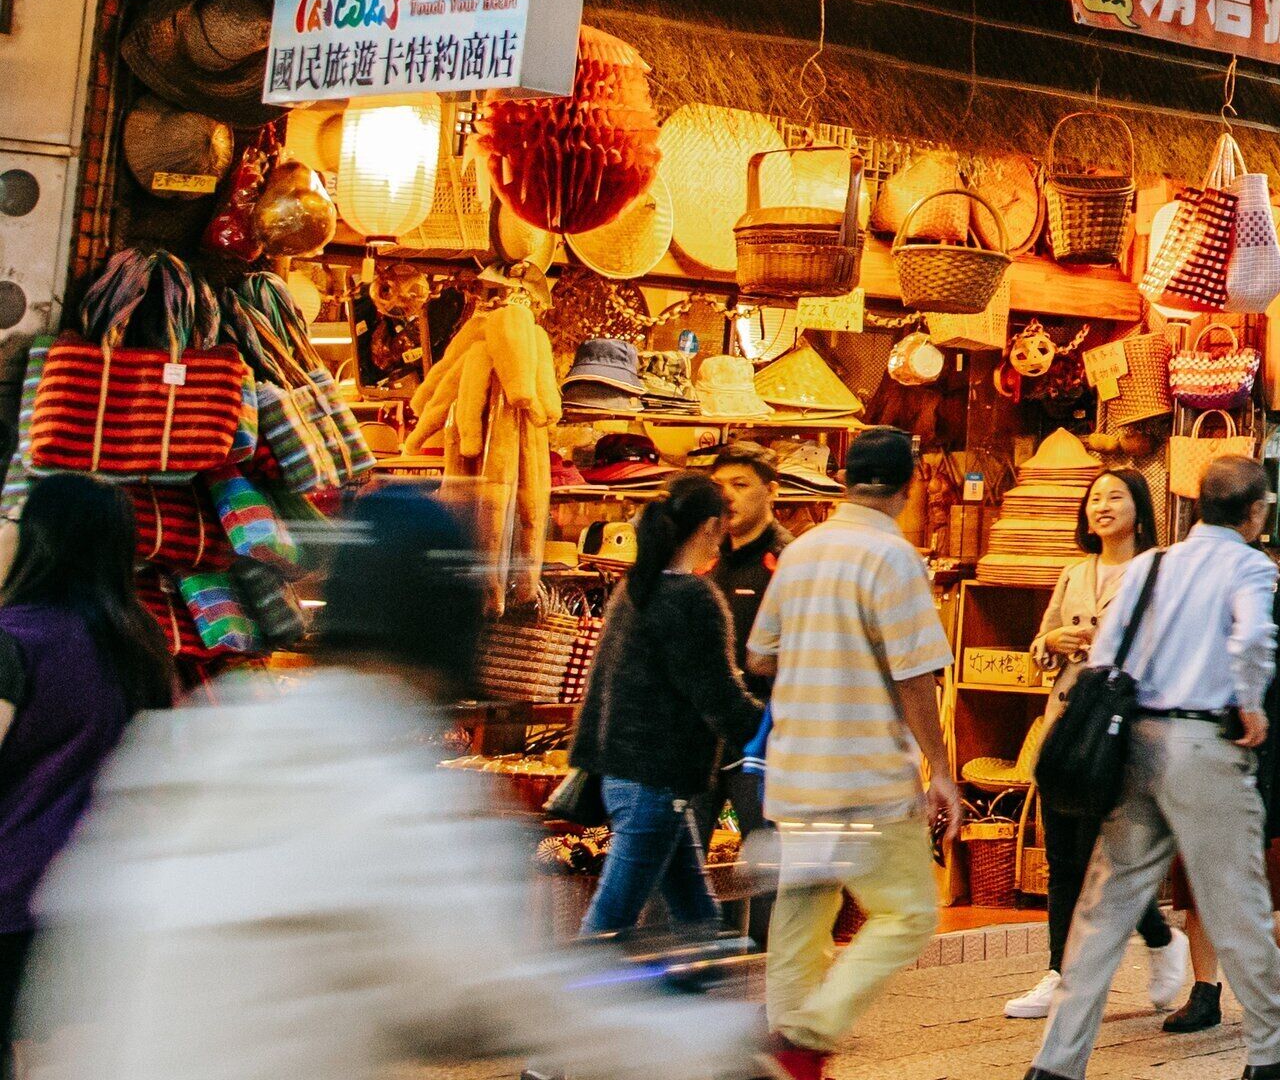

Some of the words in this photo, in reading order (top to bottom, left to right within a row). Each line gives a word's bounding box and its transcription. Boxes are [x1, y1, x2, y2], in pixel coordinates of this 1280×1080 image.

[268, 28, 520, 95] 國民旅遊卡特約商店
